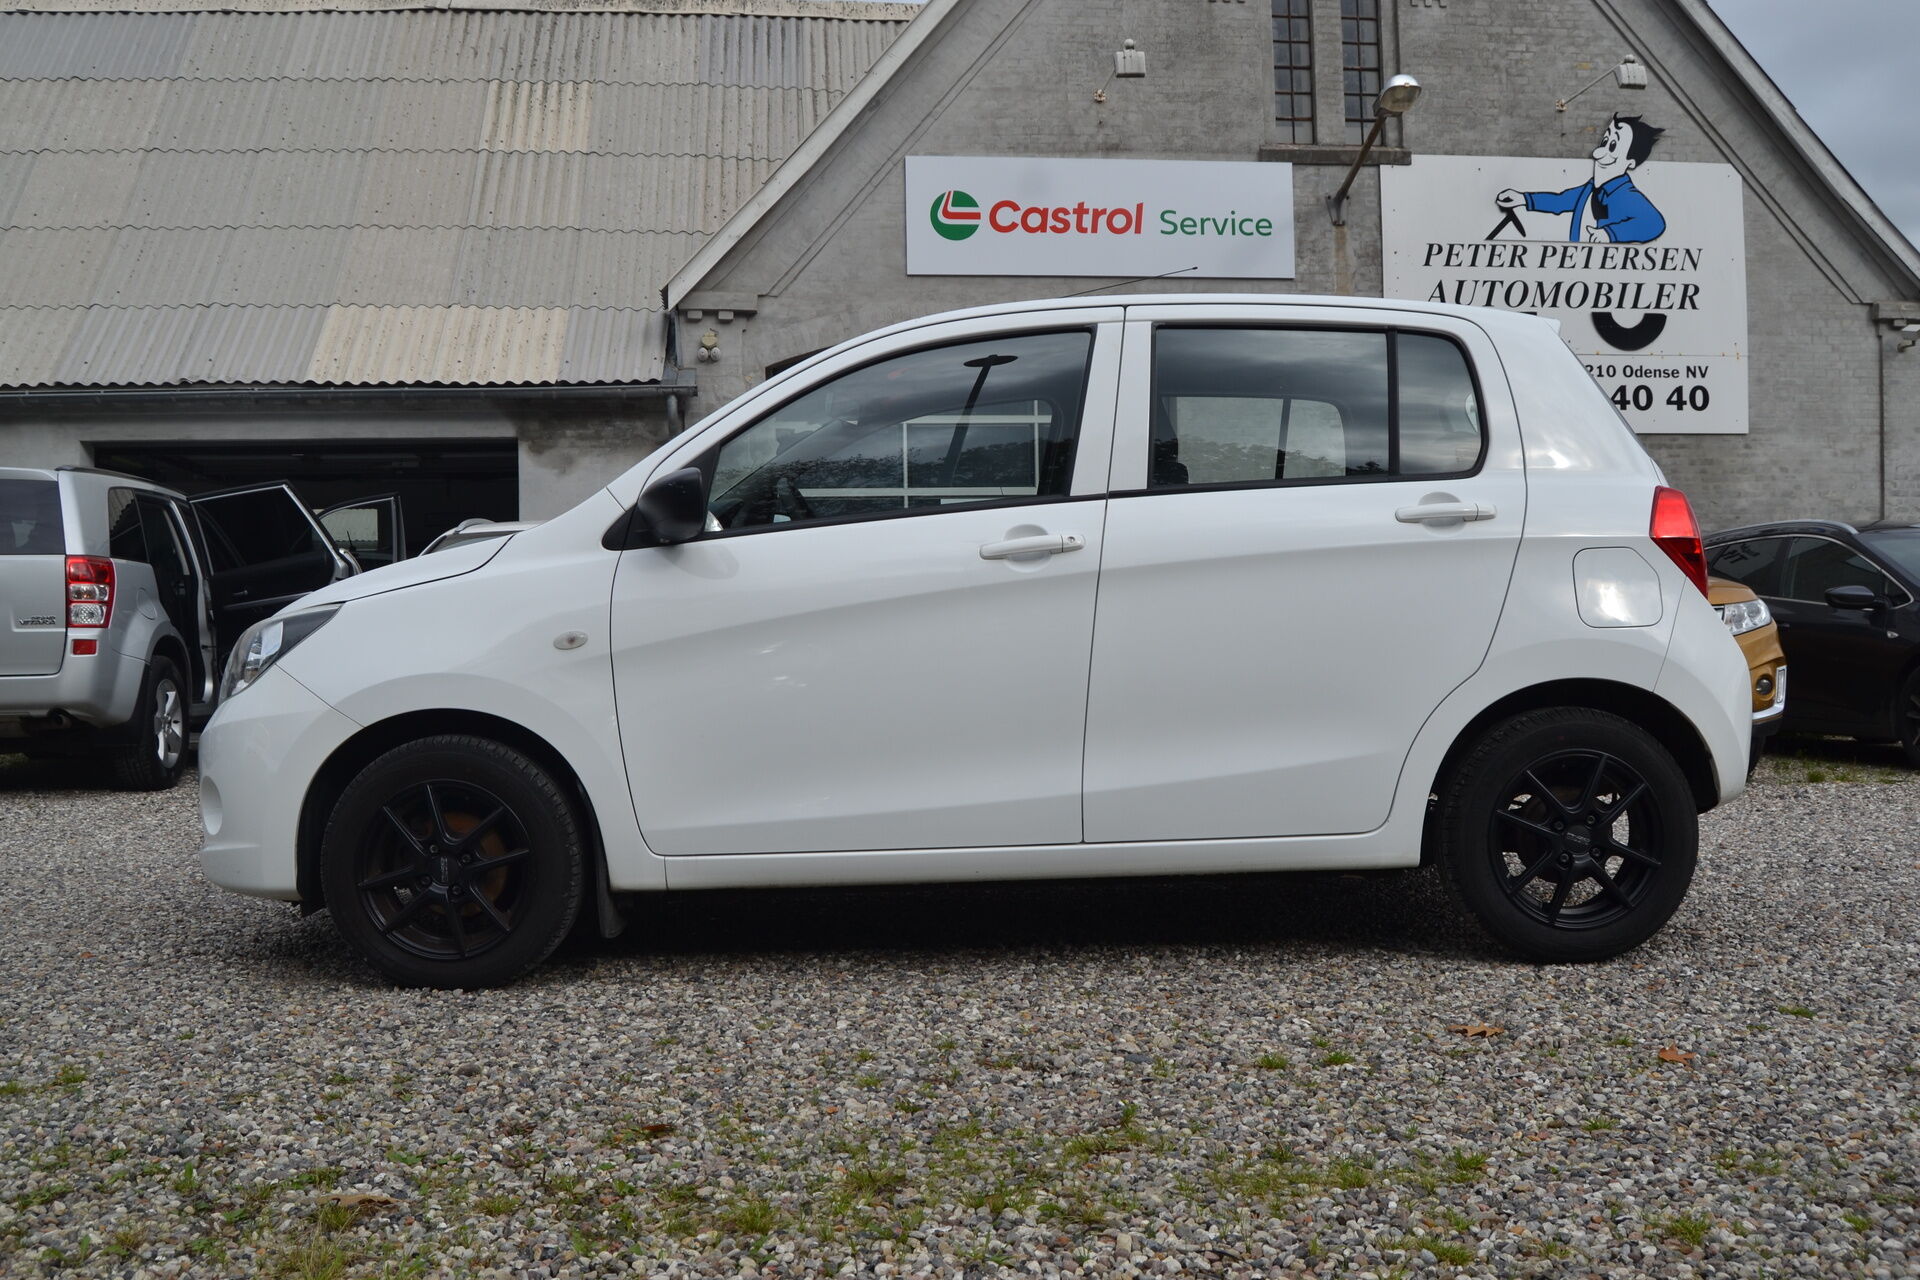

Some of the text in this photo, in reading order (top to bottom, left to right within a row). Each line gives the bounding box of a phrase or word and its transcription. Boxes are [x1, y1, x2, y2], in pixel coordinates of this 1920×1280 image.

[988, 199, 1273, 237] Castrol Service
[1422, 243, 1703, 271] PETER PETERSEN
[1427, 279, 1700, 311] AUTOMOBILER
[1622, 364, 1680, 379] Odense
[1686, 365, 1709, 379] NV
[1610, 384, 1710, 412] 40 40
